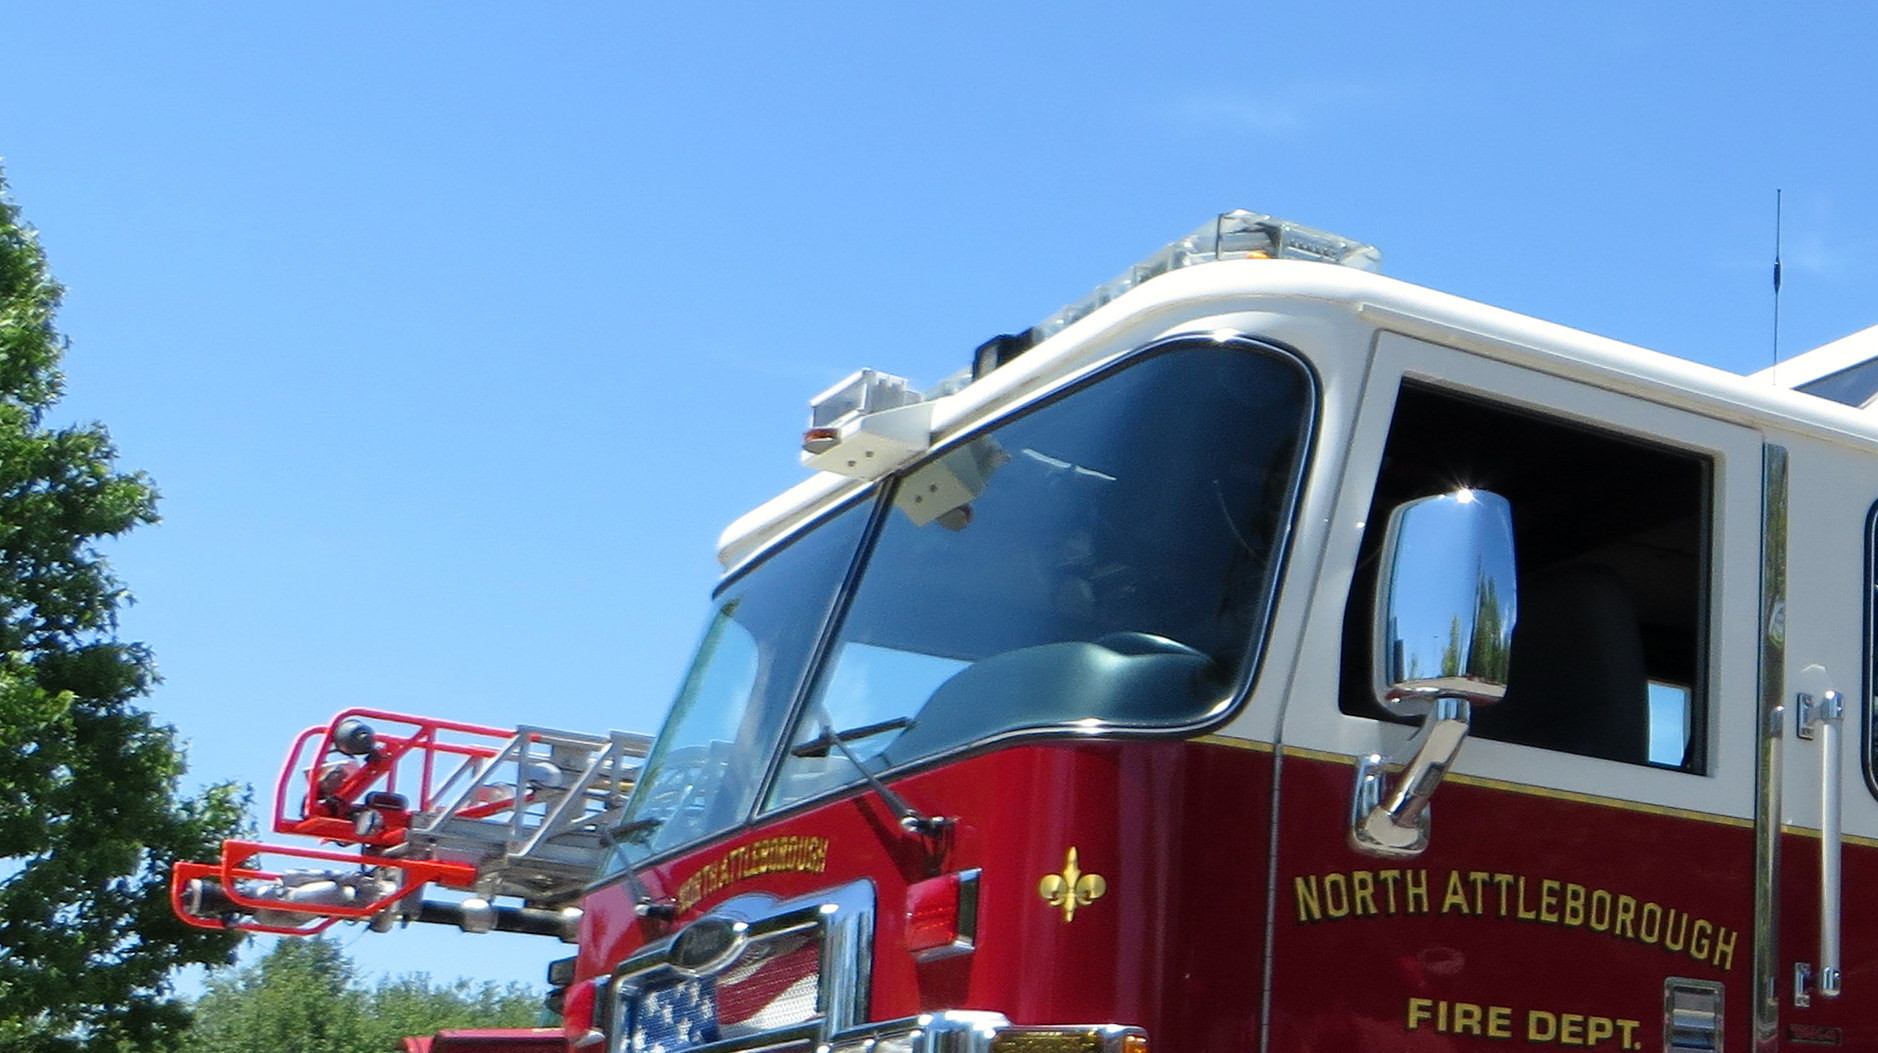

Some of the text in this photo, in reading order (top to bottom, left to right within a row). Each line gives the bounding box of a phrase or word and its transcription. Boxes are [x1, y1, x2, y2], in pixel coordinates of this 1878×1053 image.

[1294, 869, 1738, 971] NORTH ATTLEBOROUGH
[1408, 997, 1642, 1050] FIRE DEPT.
